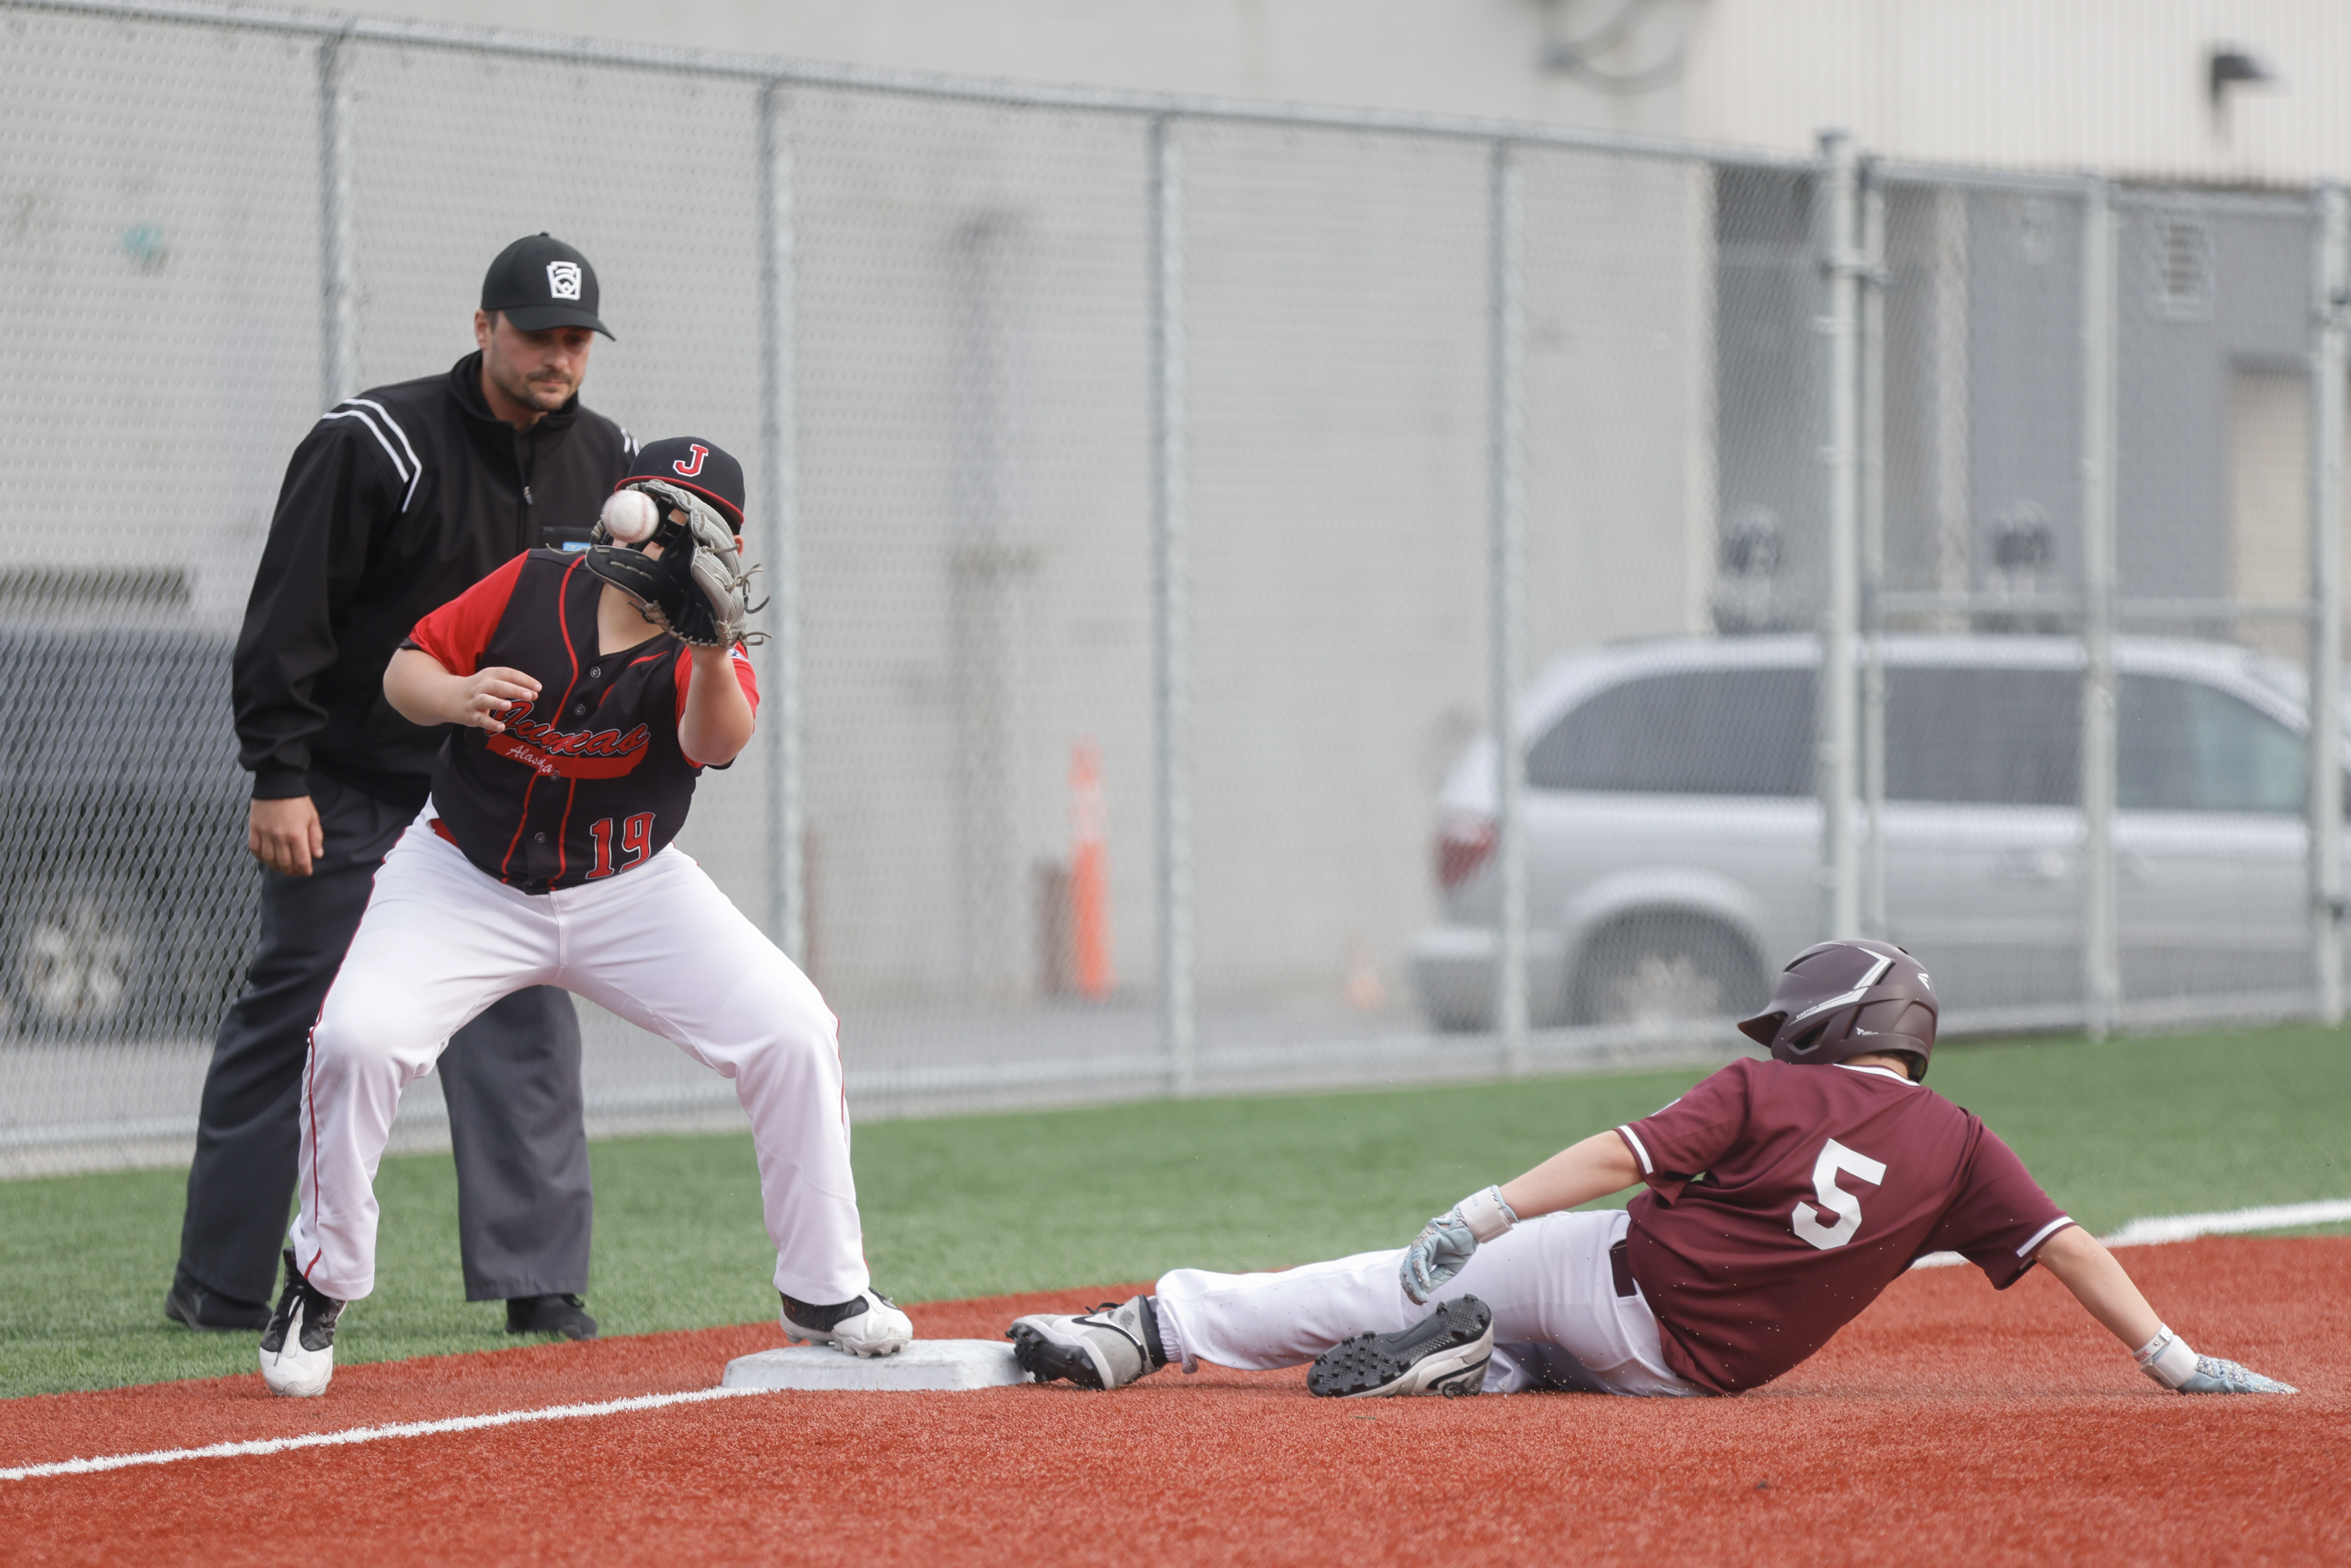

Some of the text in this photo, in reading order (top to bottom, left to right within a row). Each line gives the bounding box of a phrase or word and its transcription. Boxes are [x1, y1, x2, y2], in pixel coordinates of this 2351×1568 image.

[673, 444, 709, 477] J
[505, 745, 553, 773] Alaska
[586, 812, 656, 879] 19
[1796, 1005, 1817, 1019] EASTON
[1792, 1138, 1887, 1251] 5
